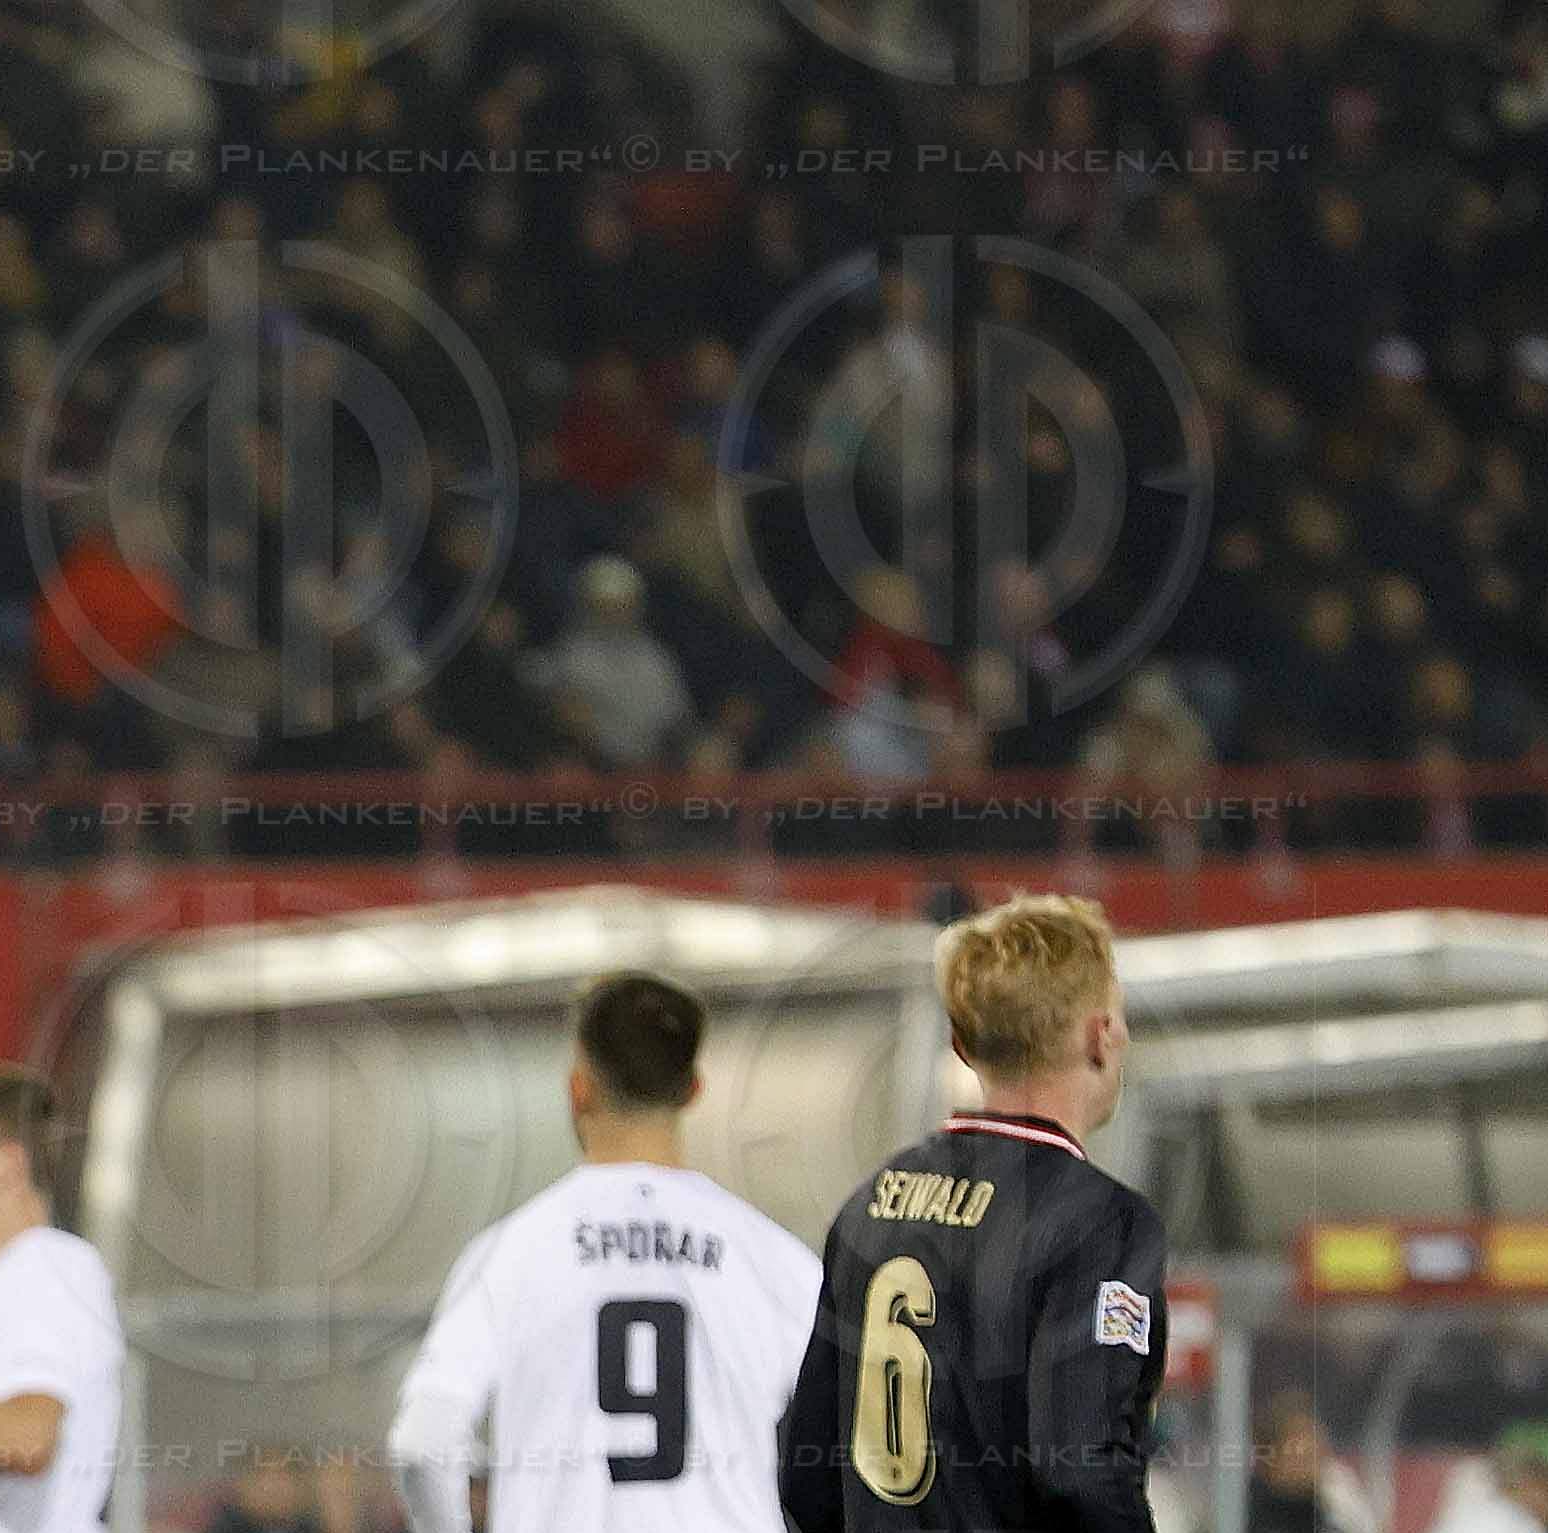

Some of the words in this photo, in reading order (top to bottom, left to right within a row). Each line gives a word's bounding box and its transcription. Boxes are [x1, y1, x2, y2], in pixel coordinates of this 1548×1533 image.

[868, 1168, 995, 1228] SEIWALD
[599, 1300, 685, 1482] 9
[852, 1256, 937, 1506] 6
